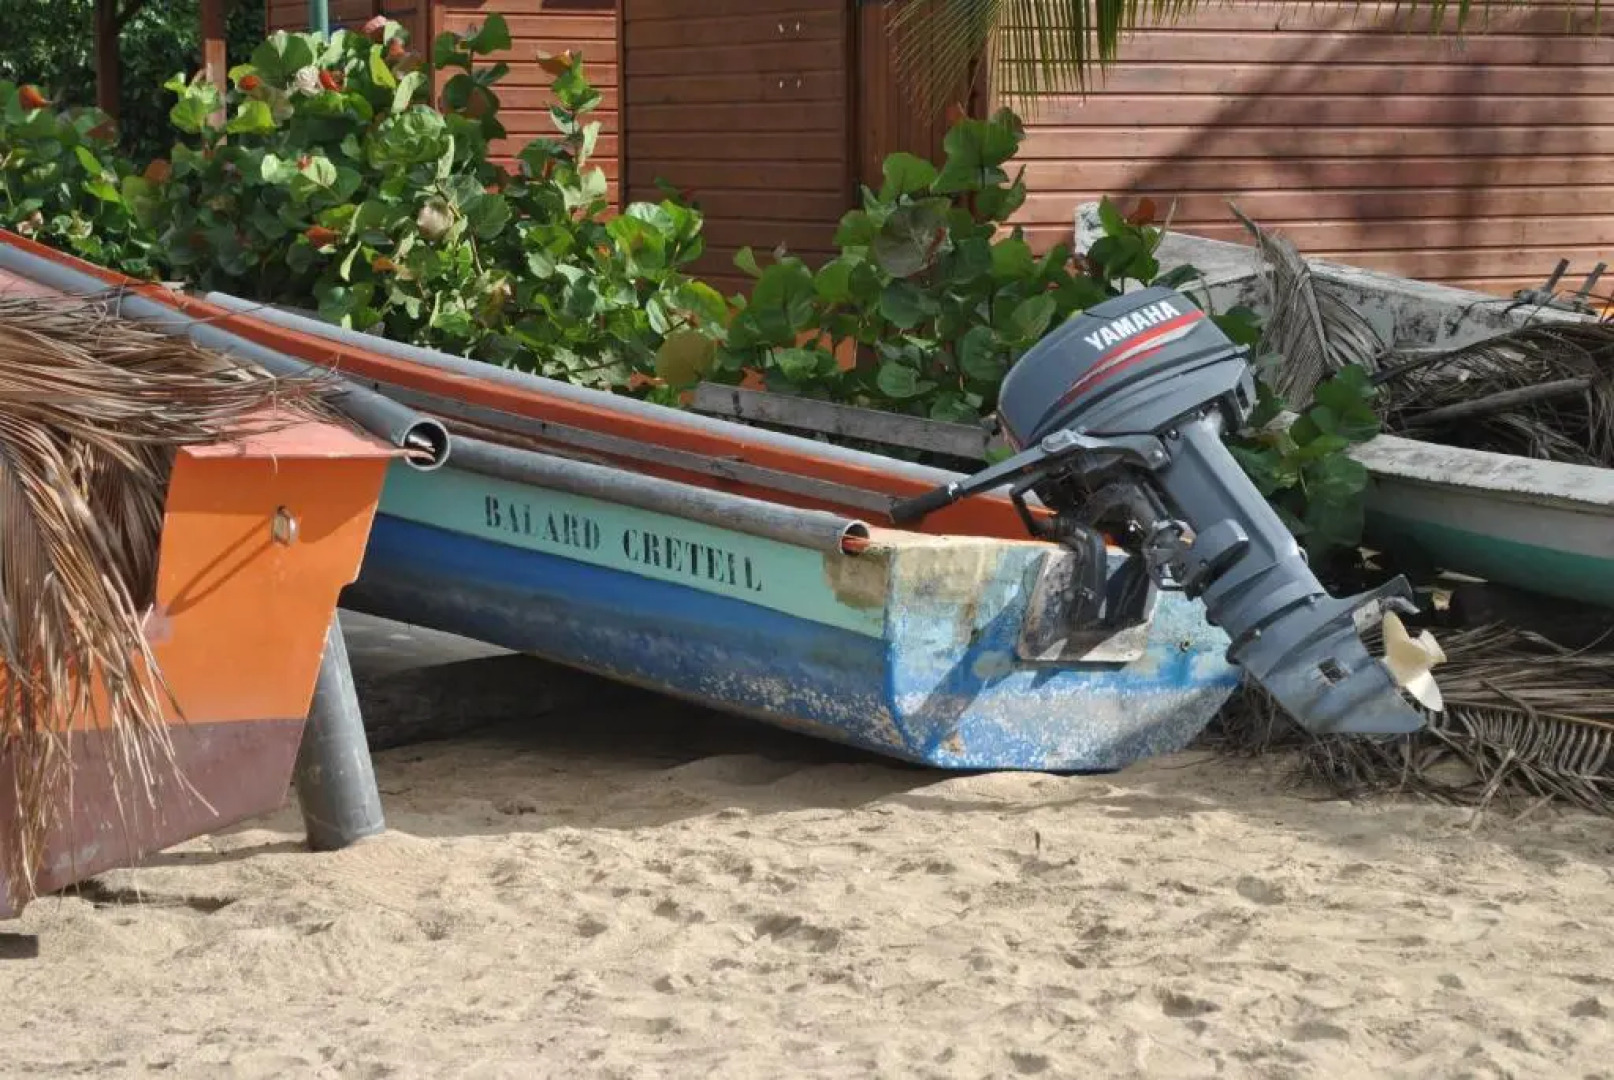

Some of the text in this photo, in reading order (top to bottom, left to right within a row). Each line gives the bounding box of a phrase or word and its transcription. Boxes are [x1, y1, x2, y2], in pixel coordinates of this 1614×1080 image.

[1083, 300, 1182, 351] YAMAHA
[484, 494, 762, 592] BALARD CRETEIL
